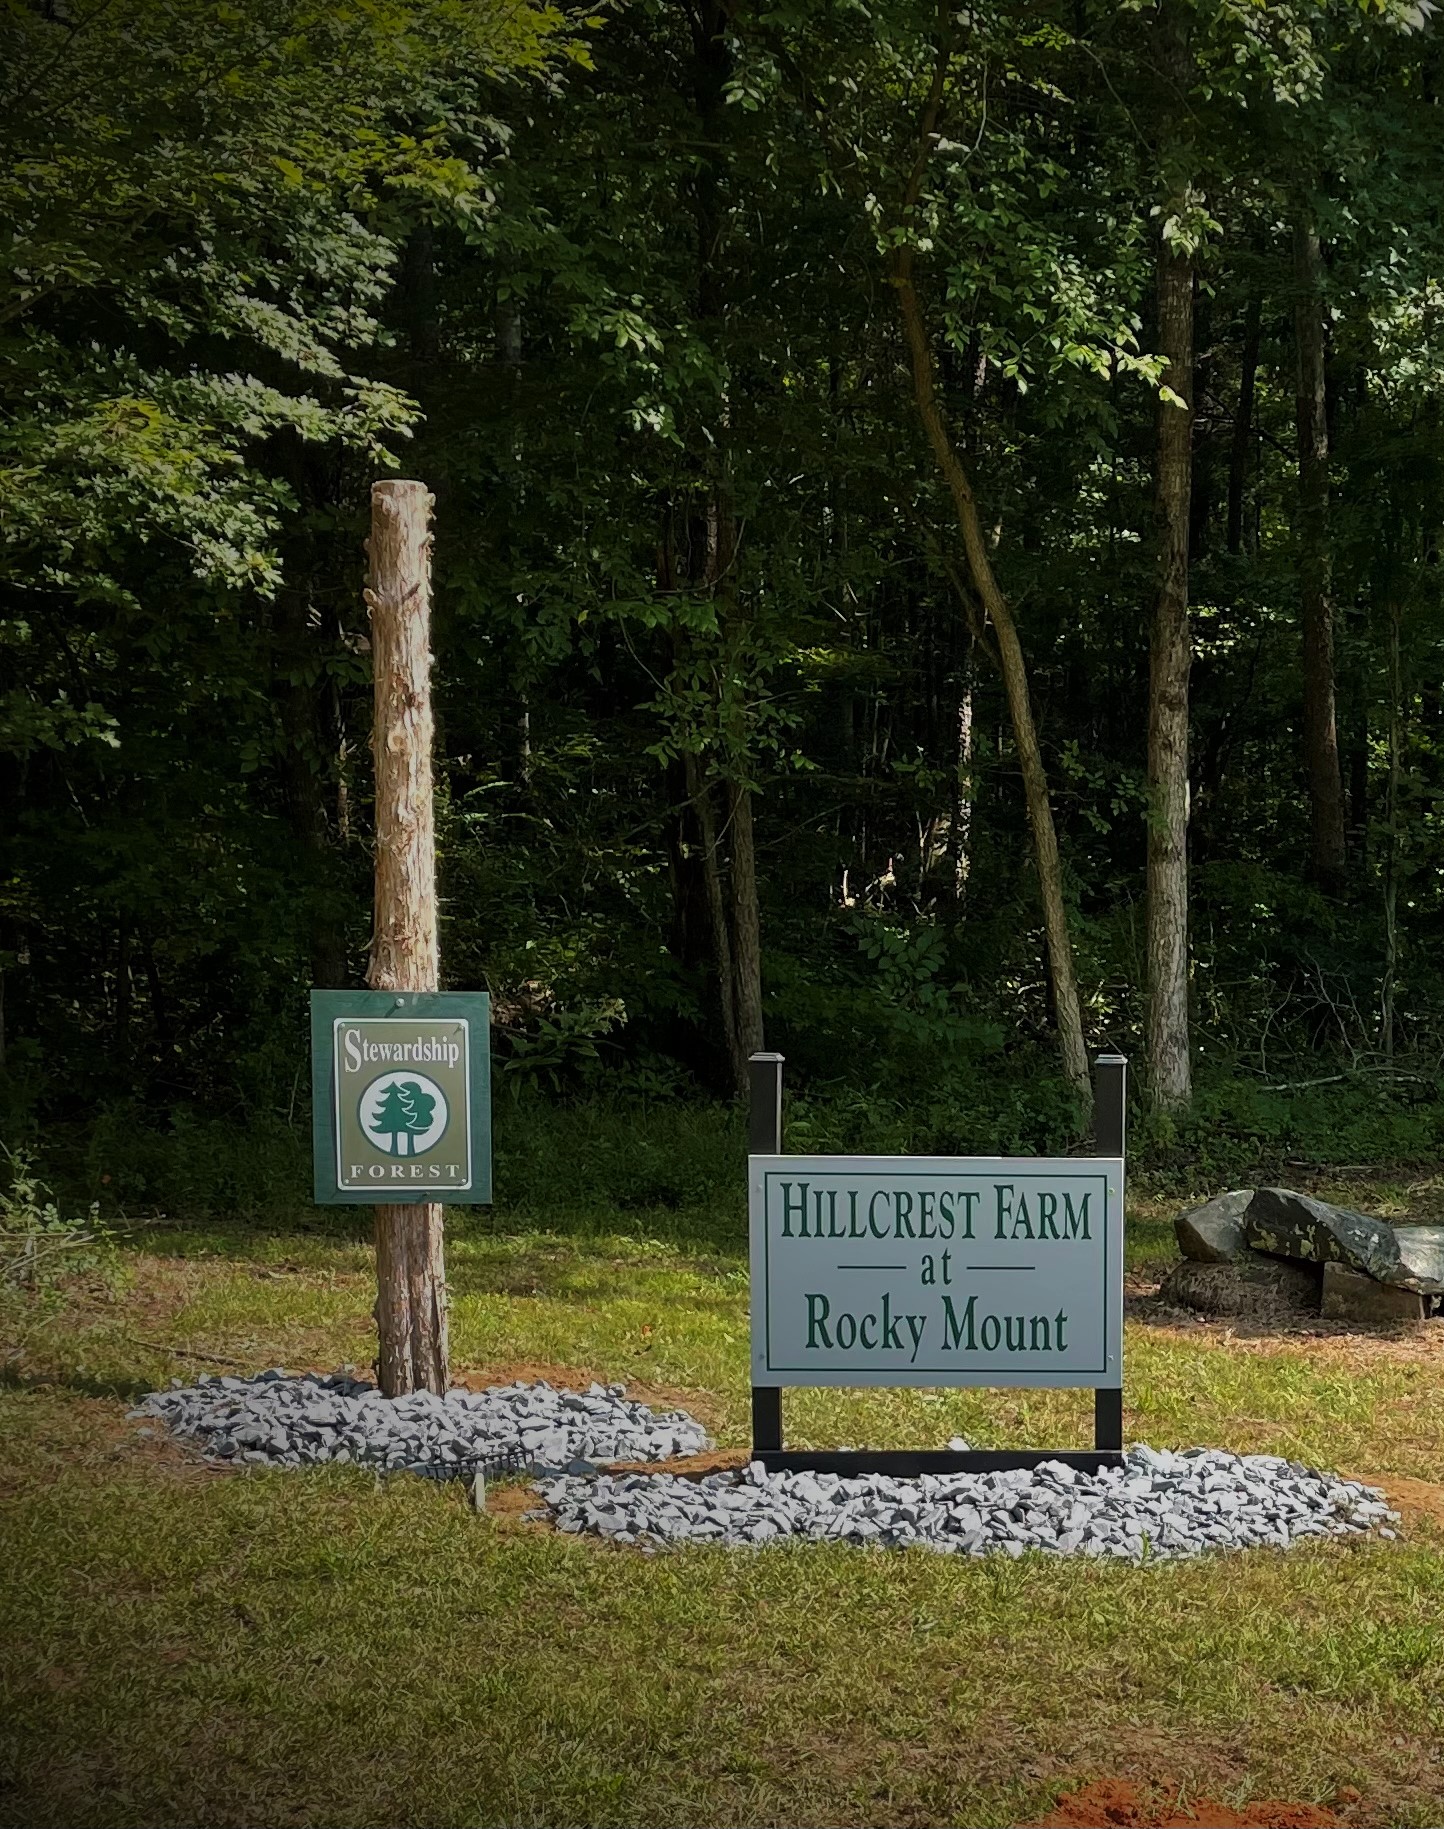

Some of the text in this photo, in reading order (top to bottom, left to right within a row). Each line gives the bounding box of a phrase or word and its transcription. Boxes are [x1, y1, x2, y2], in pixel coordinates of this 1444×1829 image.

[345, 1028, 459, 1072] Stewardship
[350, 1164, 459, 1178] FOREST
[780, 1182, 1092, 1240] HILLCREST FARM
[921, 1248, 952, 1285] at
[804, 1292, 1068, 1363] Rocky Mount
